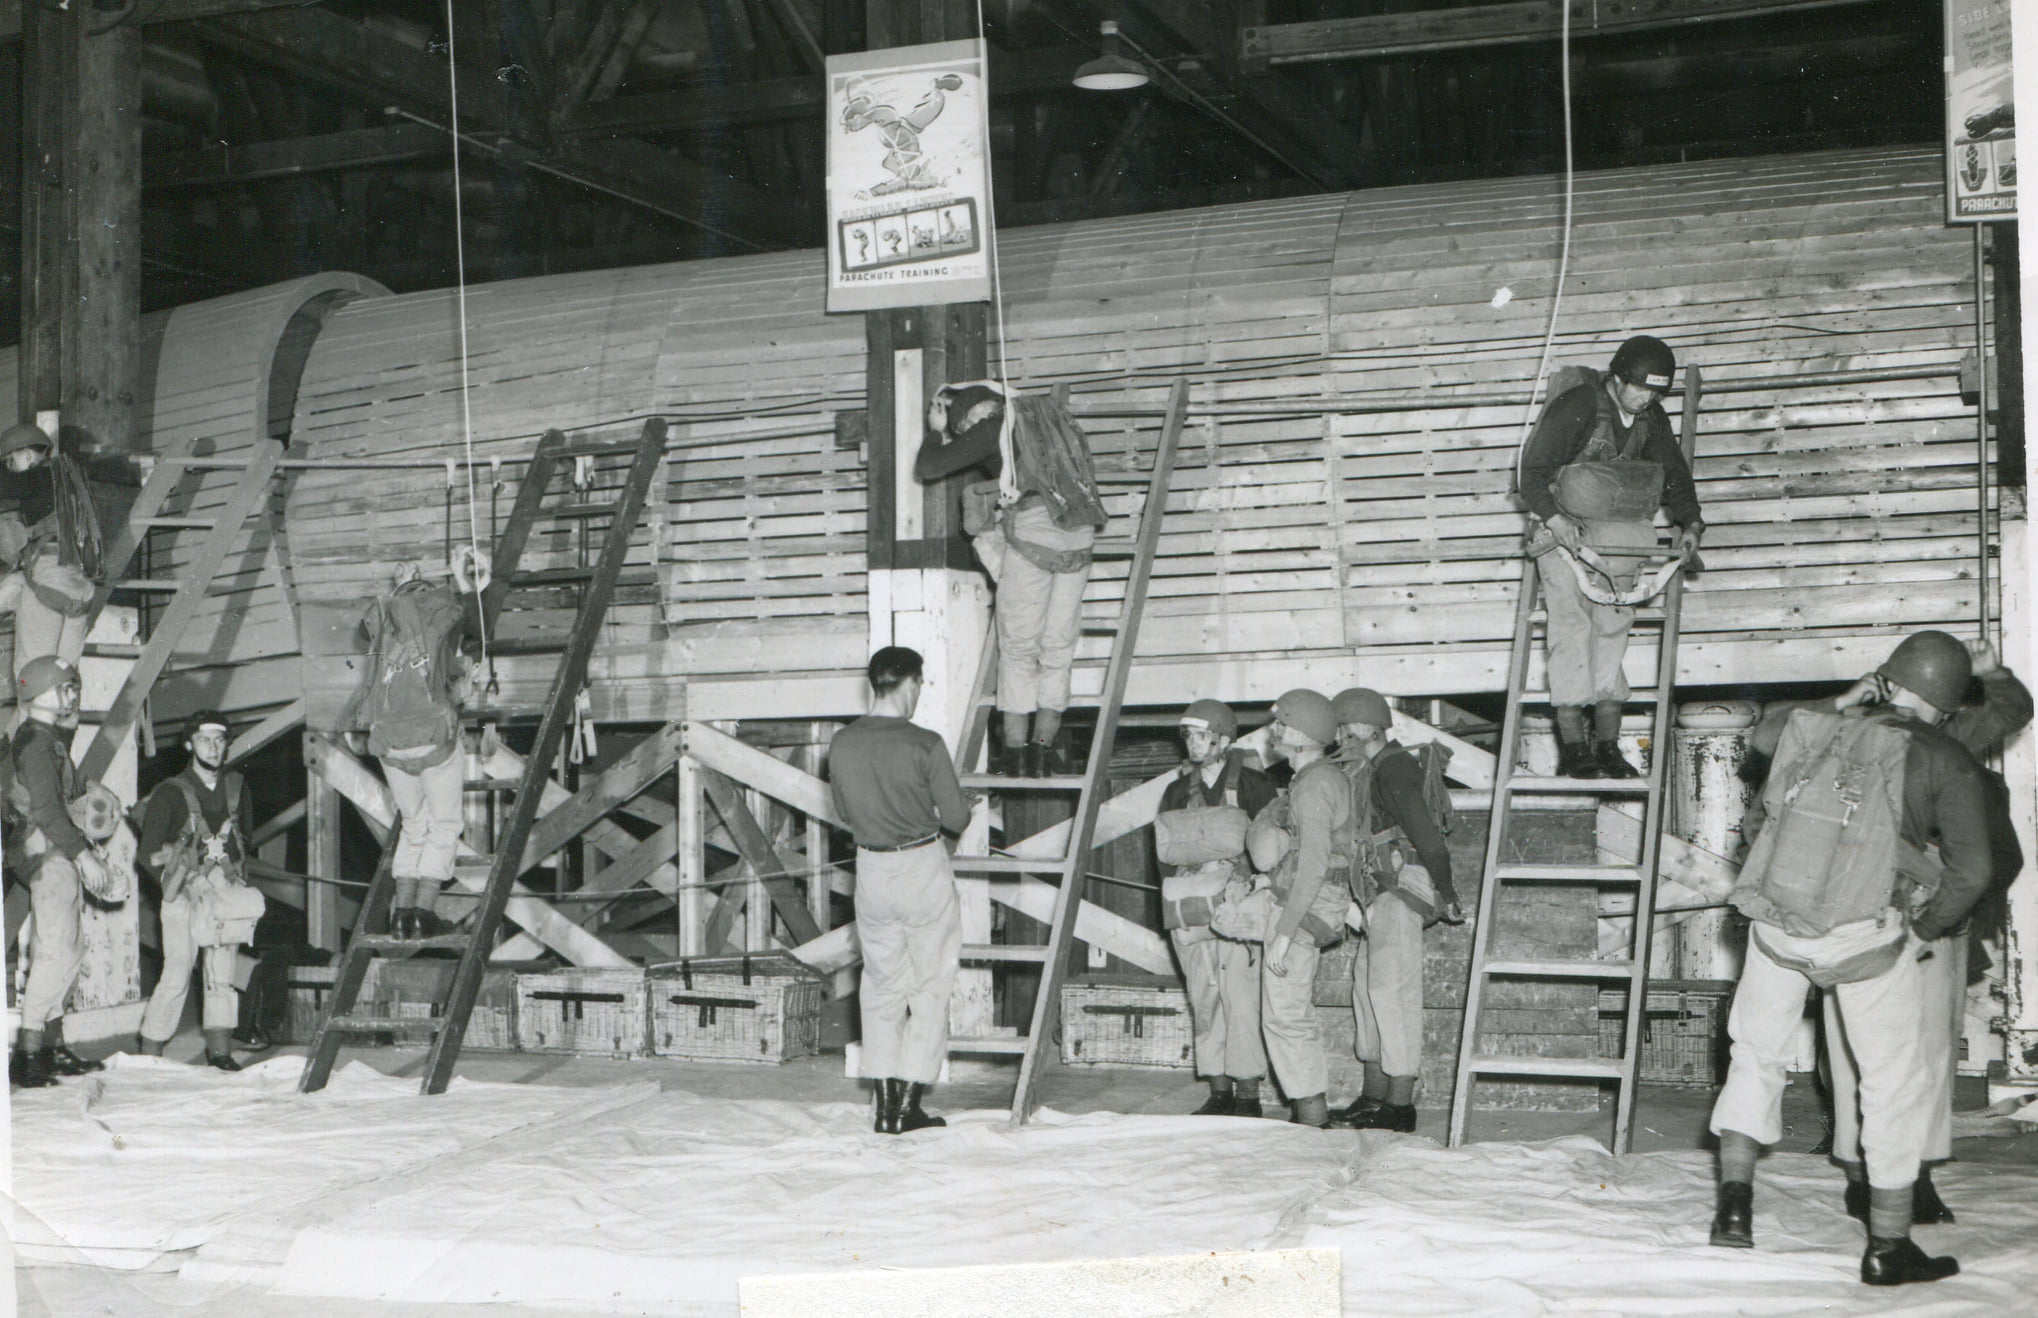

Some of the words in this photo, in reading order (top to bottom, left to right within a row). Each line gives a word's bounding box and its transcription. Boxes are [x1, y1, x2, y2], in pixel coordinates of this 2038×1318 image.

[1959, 7, 1991, 26] SIDE
[839, 271, 894, 282] PARACHUTE
[901, 266, 949, 278] TRAINING
